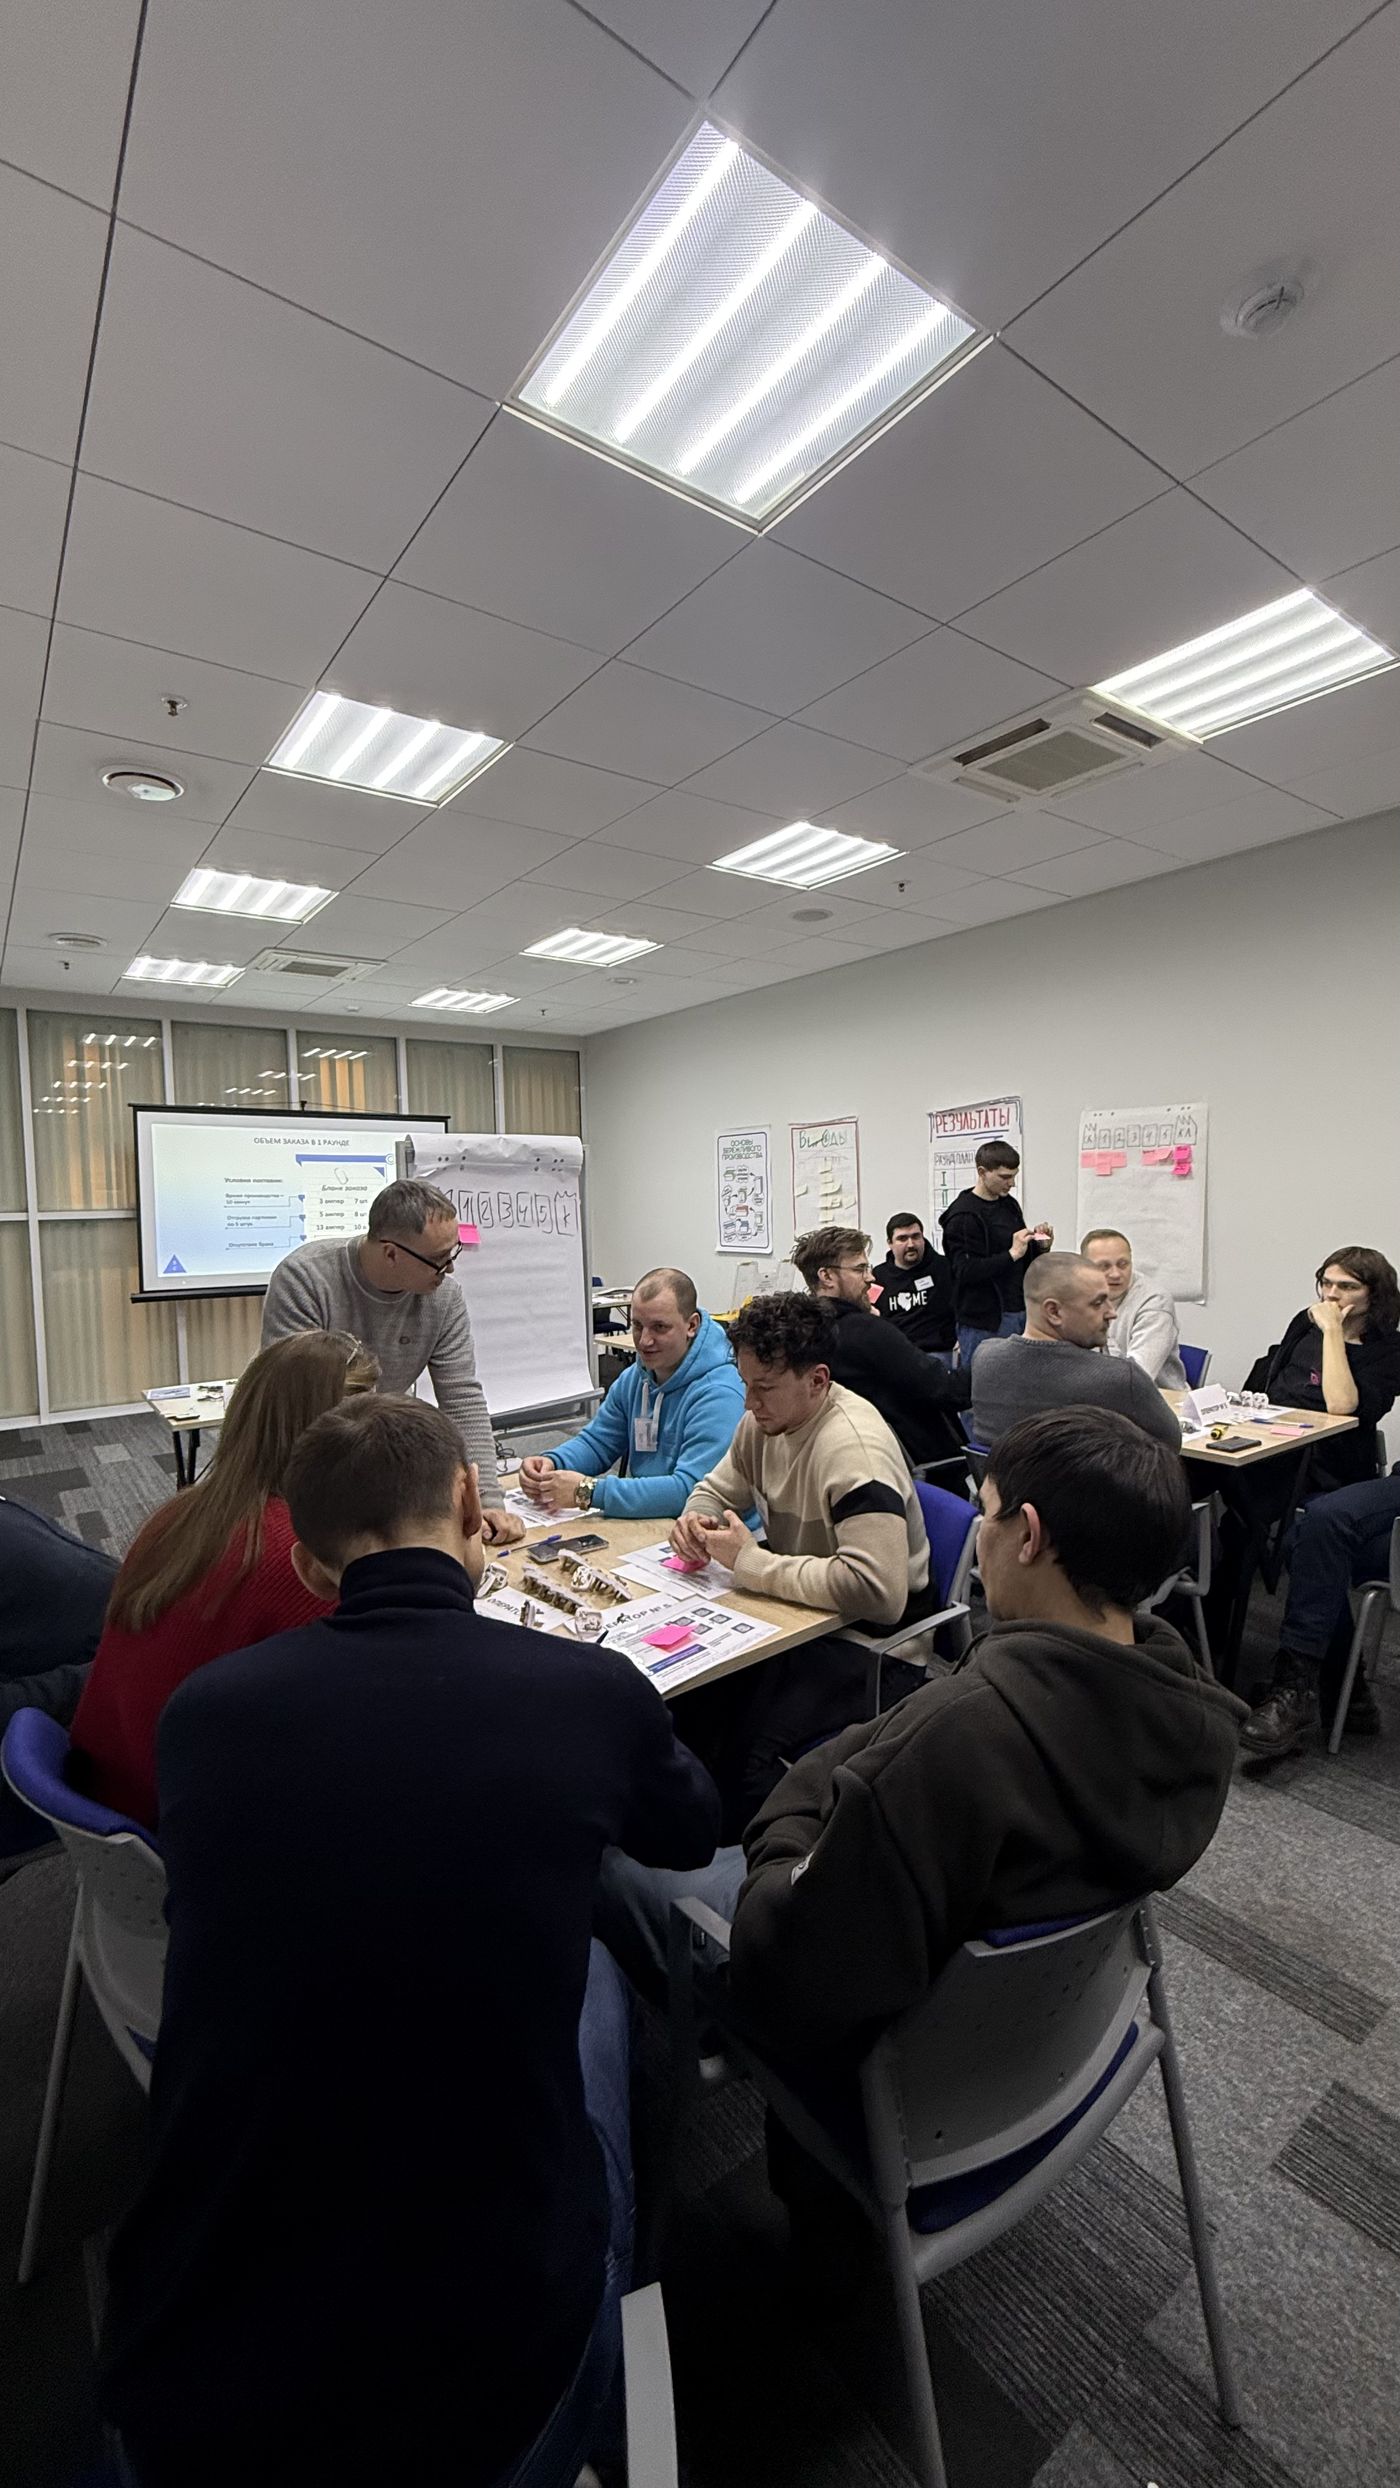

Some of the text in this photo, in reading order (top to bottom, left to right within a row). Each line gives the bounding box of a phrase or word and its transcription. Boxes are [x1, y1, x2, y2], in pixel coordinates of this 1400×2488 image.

[935, 1107, 1010, 1134] РЕЗУЛЬТАТЫ
[323, 1139, 350, 1147] РАУНДЕ
[463, 1197, 469, 1223] 1
[480, 1200, 490, 1221] 2
[500, 1202, 512, 1220] 3
[539, 1205, 547, 1223] 5
